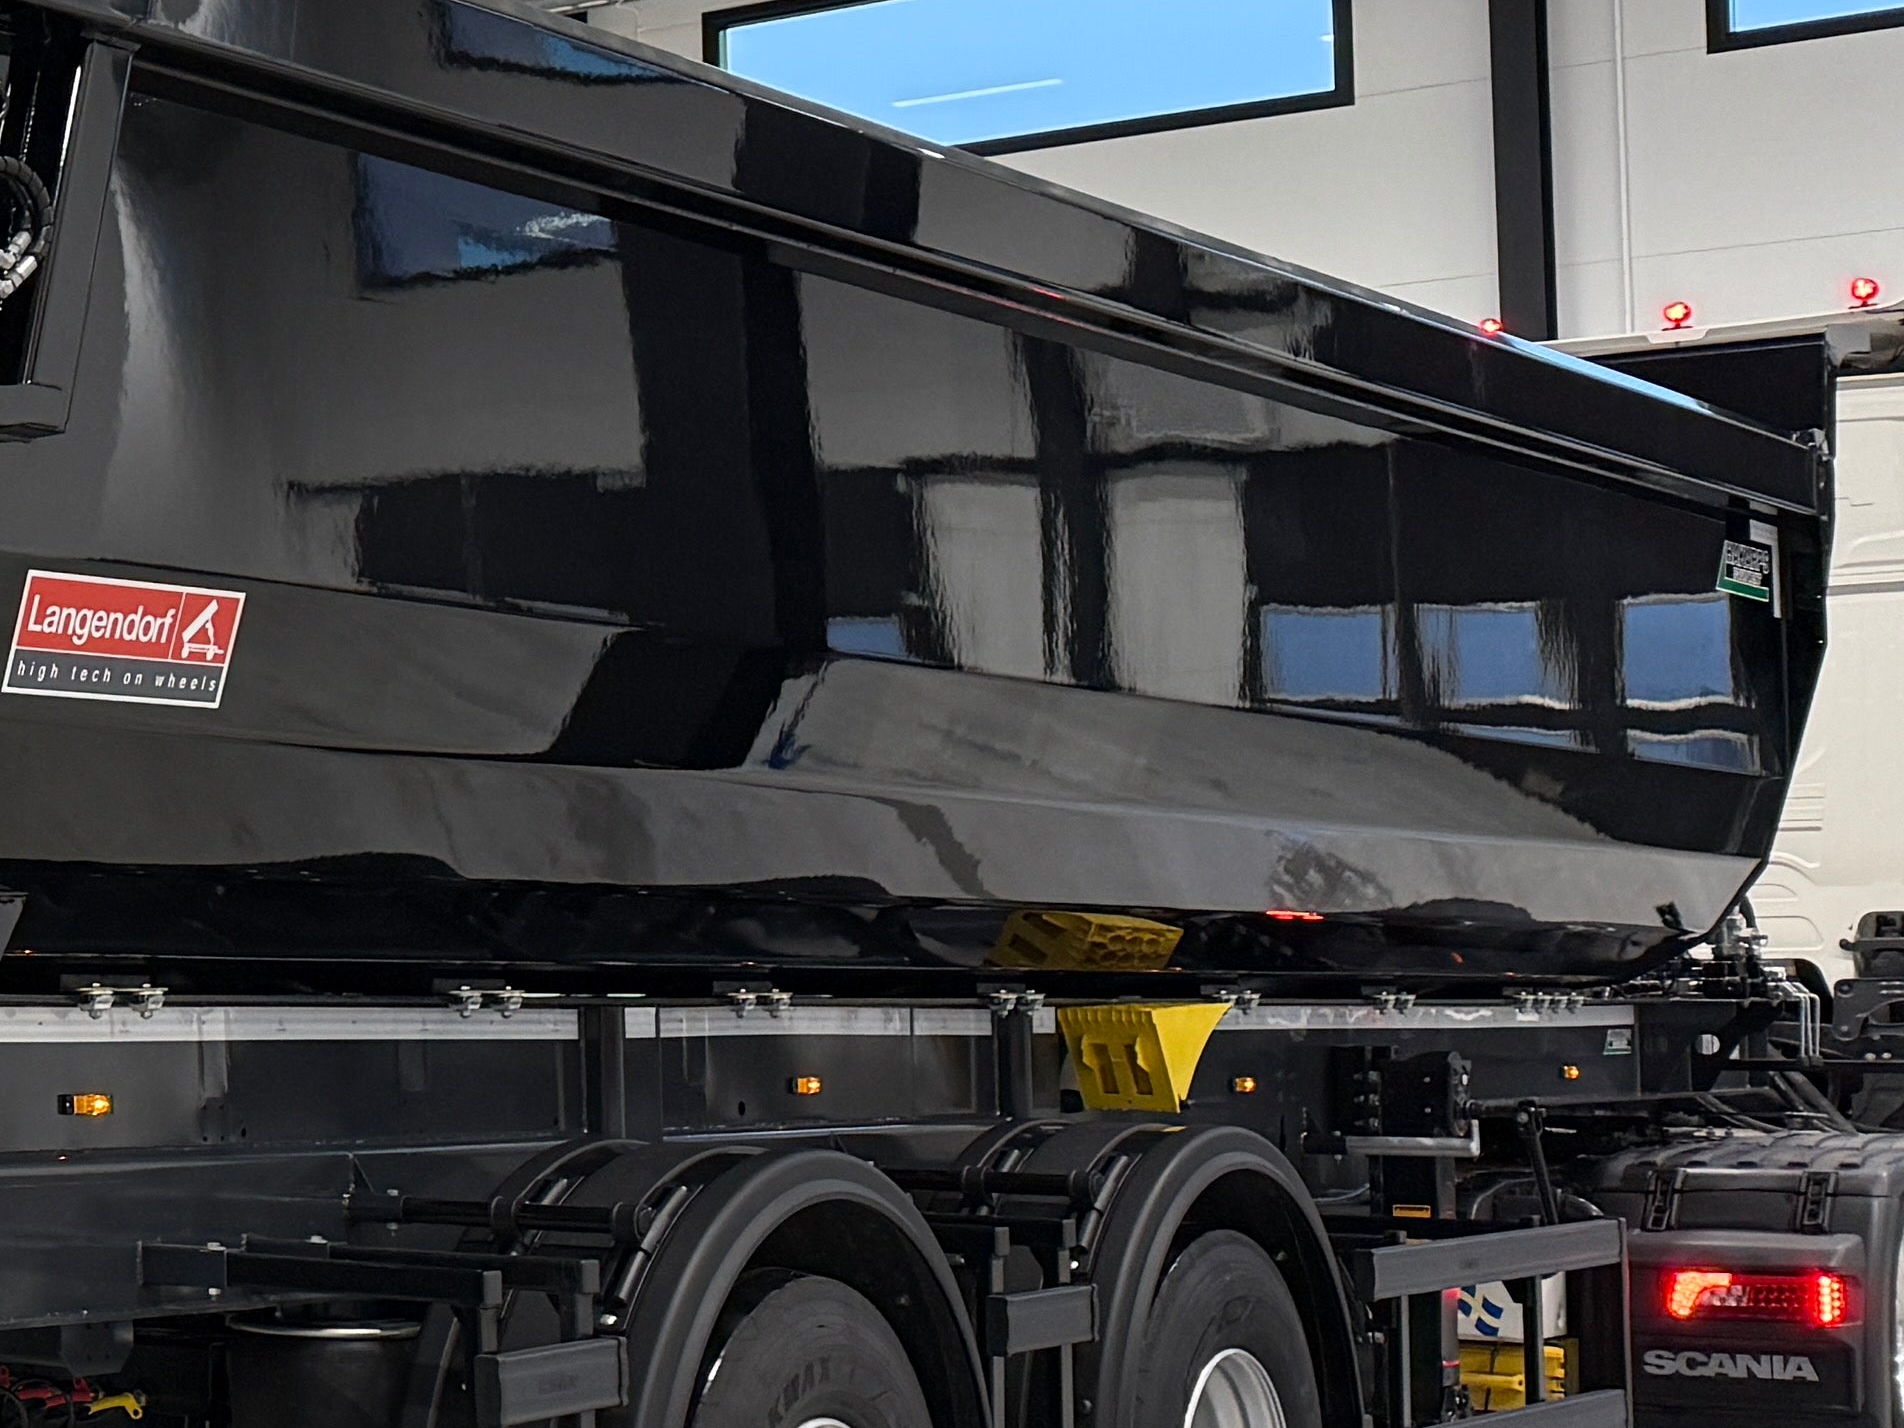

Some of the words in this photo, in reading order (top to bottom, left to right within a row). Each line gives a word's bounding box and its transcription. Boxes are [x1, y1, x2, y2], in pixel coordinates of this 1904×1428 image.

[27, 594, 176, 645] Langendorf
[17, 660, 59, 682] high
[71, 666, 111, 682] tech
[123, 673, 142, 685] on
[155, 673, 217, 691] wheels
[1643, 1350, 1820, 1382] SCANIA
